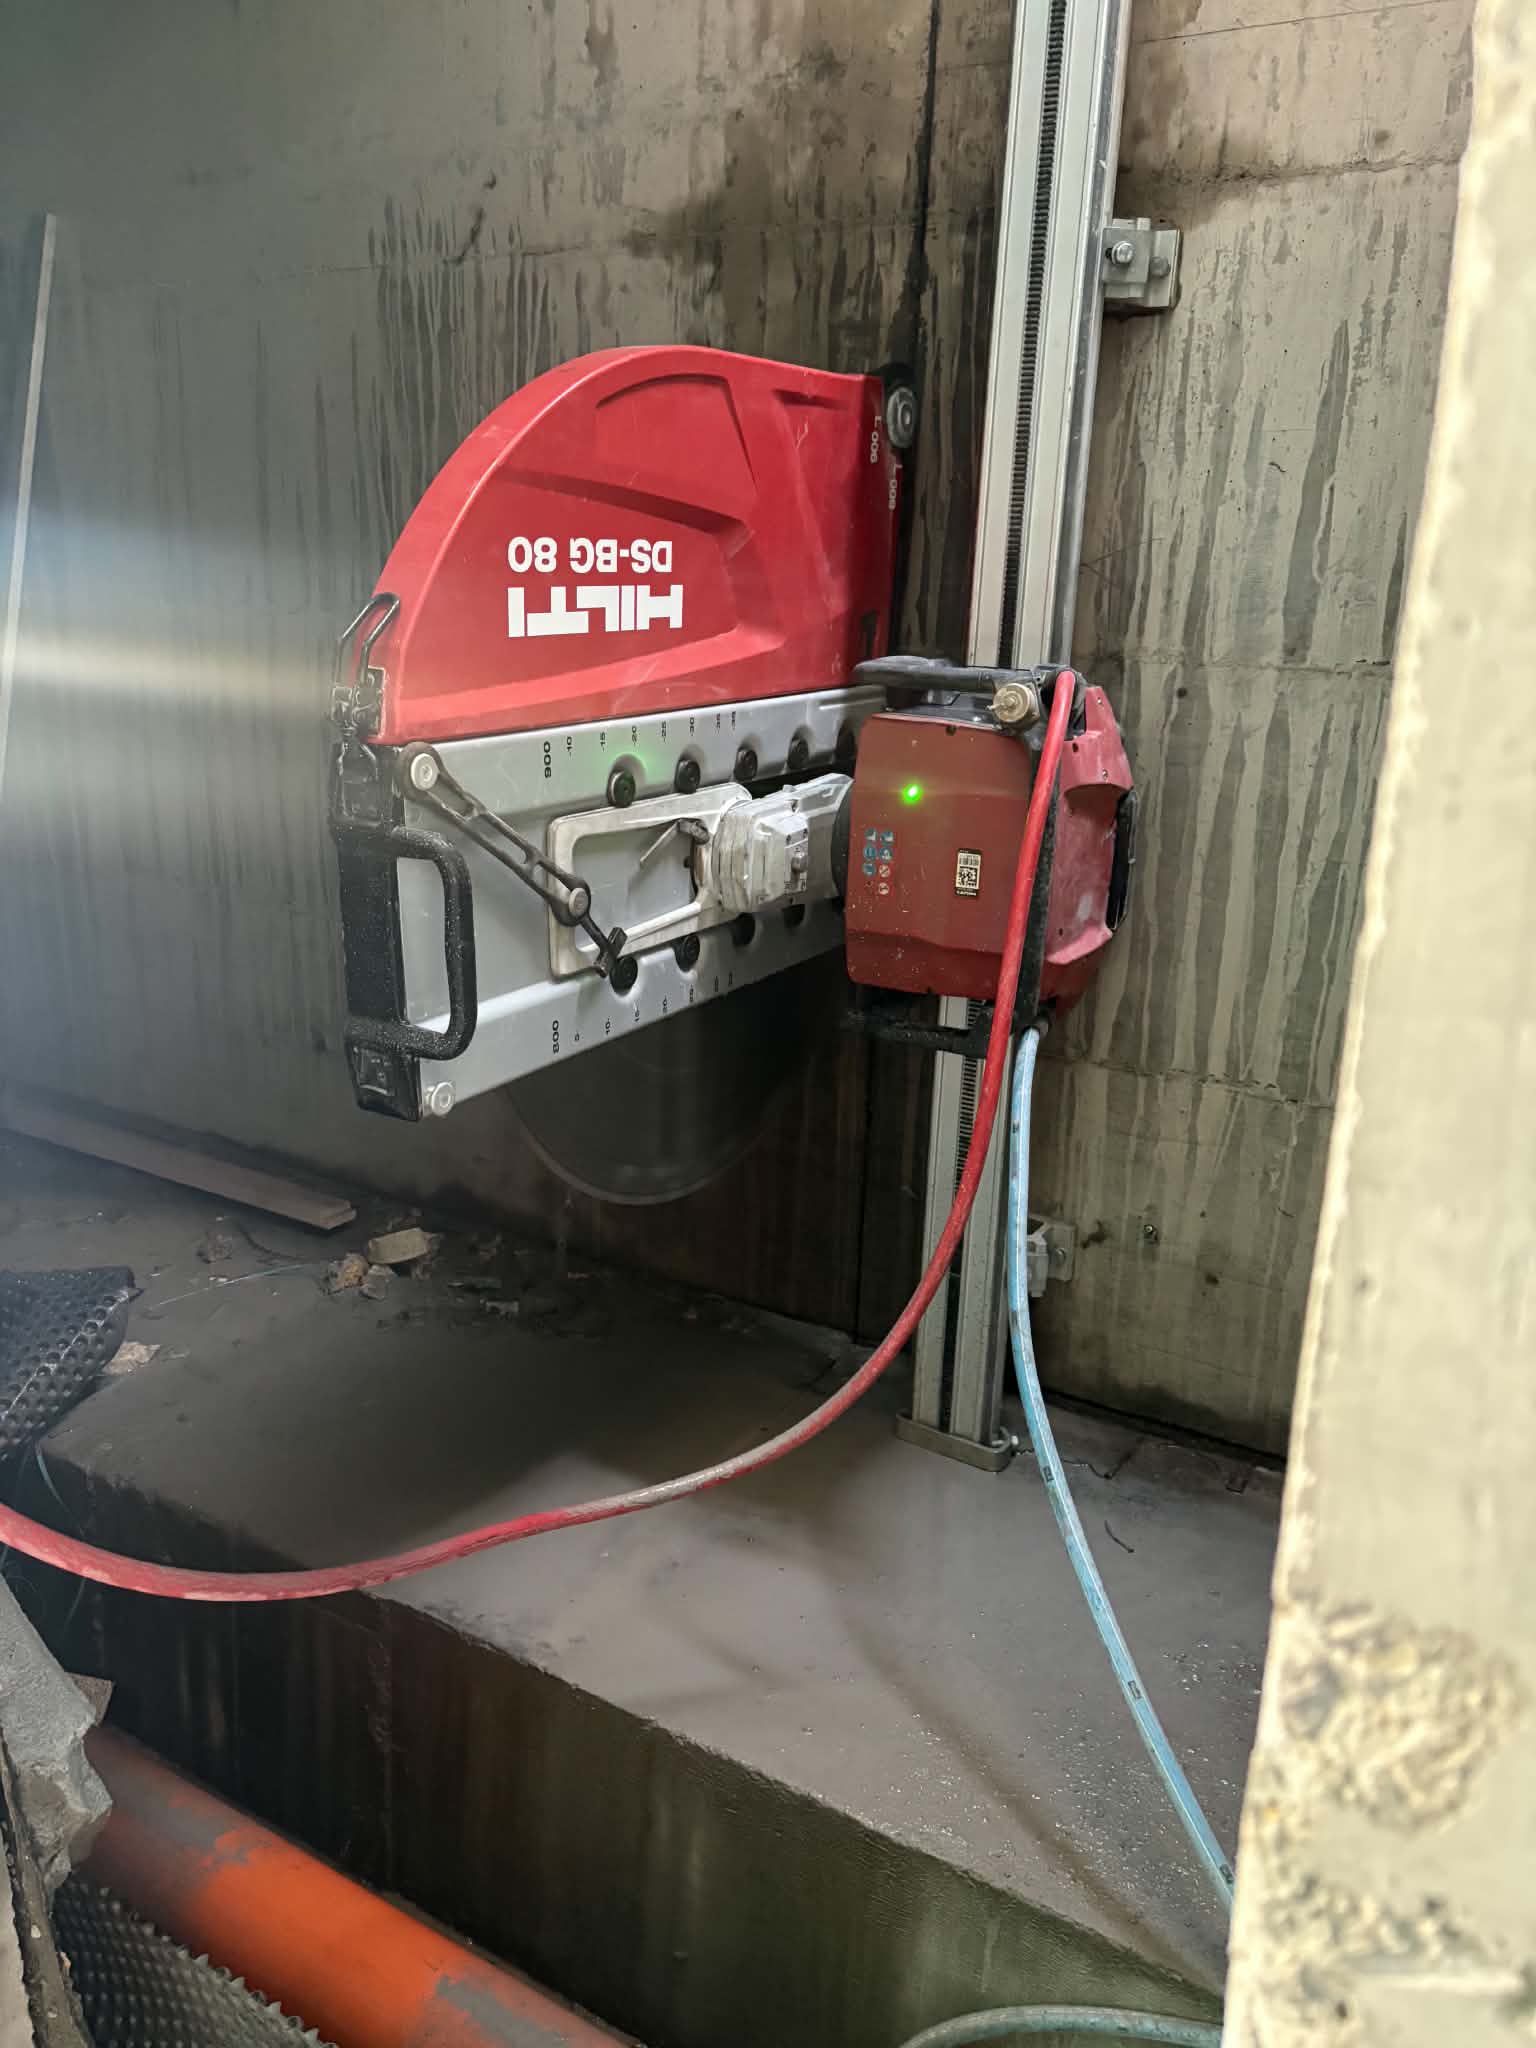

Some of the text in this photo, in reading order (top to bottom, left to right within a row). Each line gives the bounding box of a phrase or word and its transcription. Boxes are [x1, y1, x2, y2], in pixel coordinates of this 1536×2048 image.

[508, 536, 672, 573] DS-BG 80
[507, 584, 683, 638] HILTI
